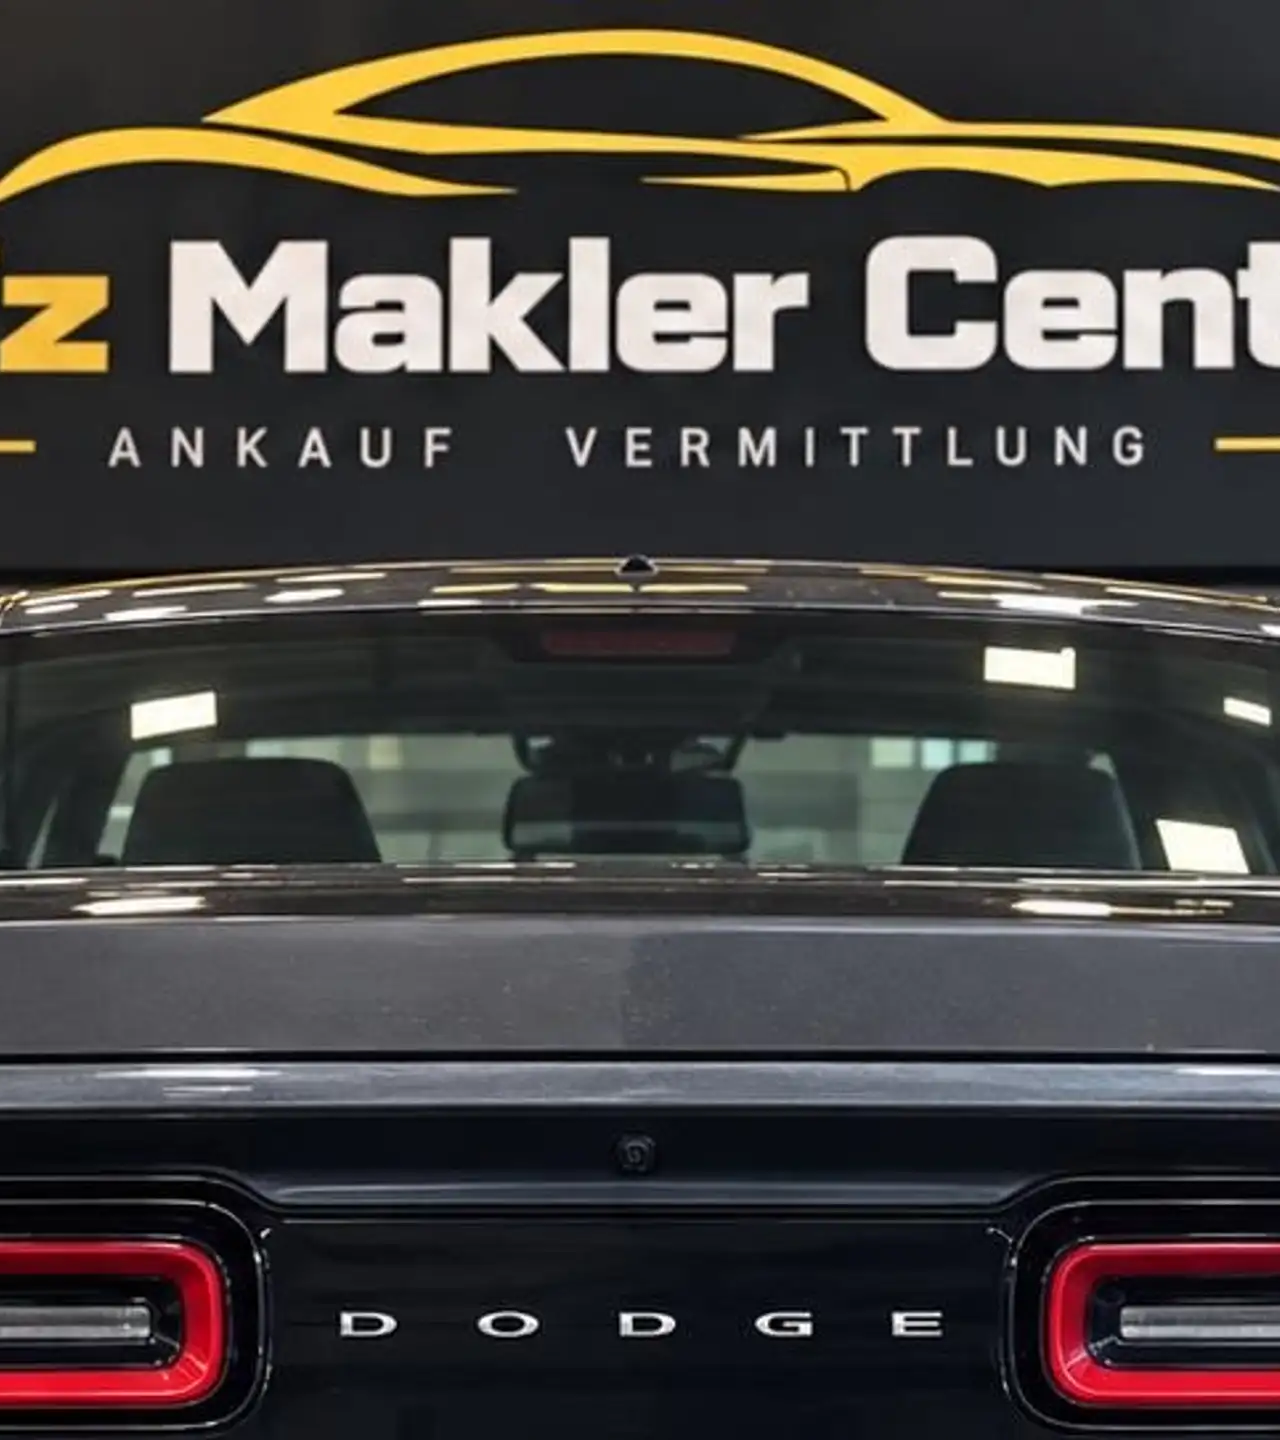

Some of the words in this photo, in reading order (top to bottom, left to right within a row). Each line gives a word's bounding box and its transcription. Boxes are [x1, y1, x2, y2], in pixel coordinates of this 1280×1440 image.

[169, 236, 809, 373] Makler
[108, 427, 454, 469] ANKAUF
[565, 425, 1147, 468] VERMITTLUNG
[339, 1310, 943, 1338] DODGE
